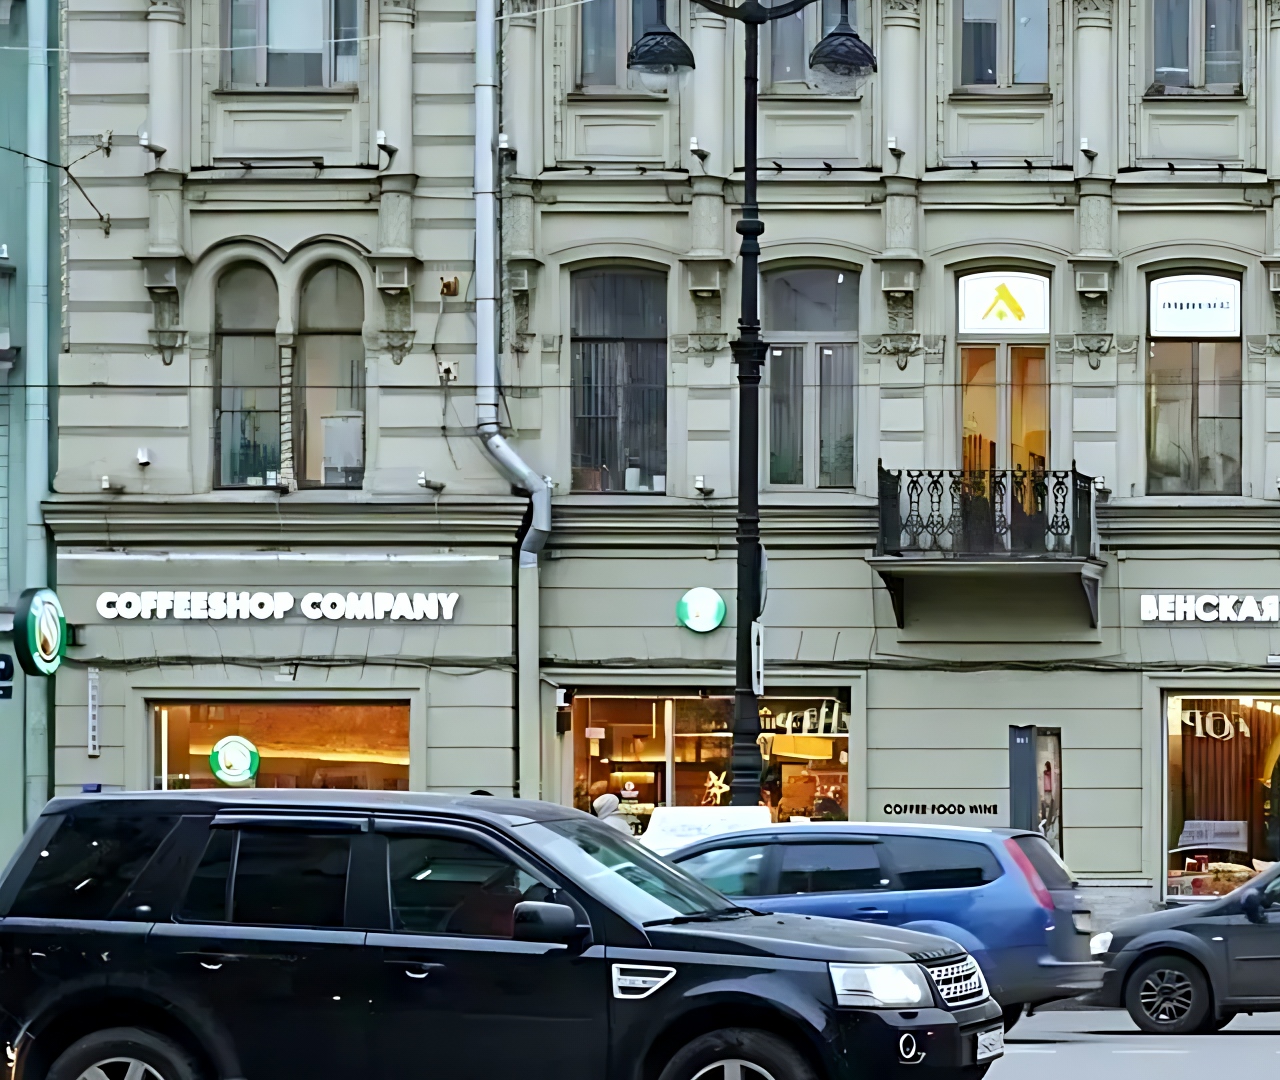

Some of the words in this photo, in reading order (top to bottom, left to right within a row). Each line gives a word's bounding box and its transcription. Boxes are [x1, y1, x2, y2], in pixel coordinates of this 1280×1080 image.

[96, 590, 295, 621] COFFEESHOP
[300, 591, 460, 621] COMPANY
[1140, 594, 1279, 622] ВЕНСКАЯ
